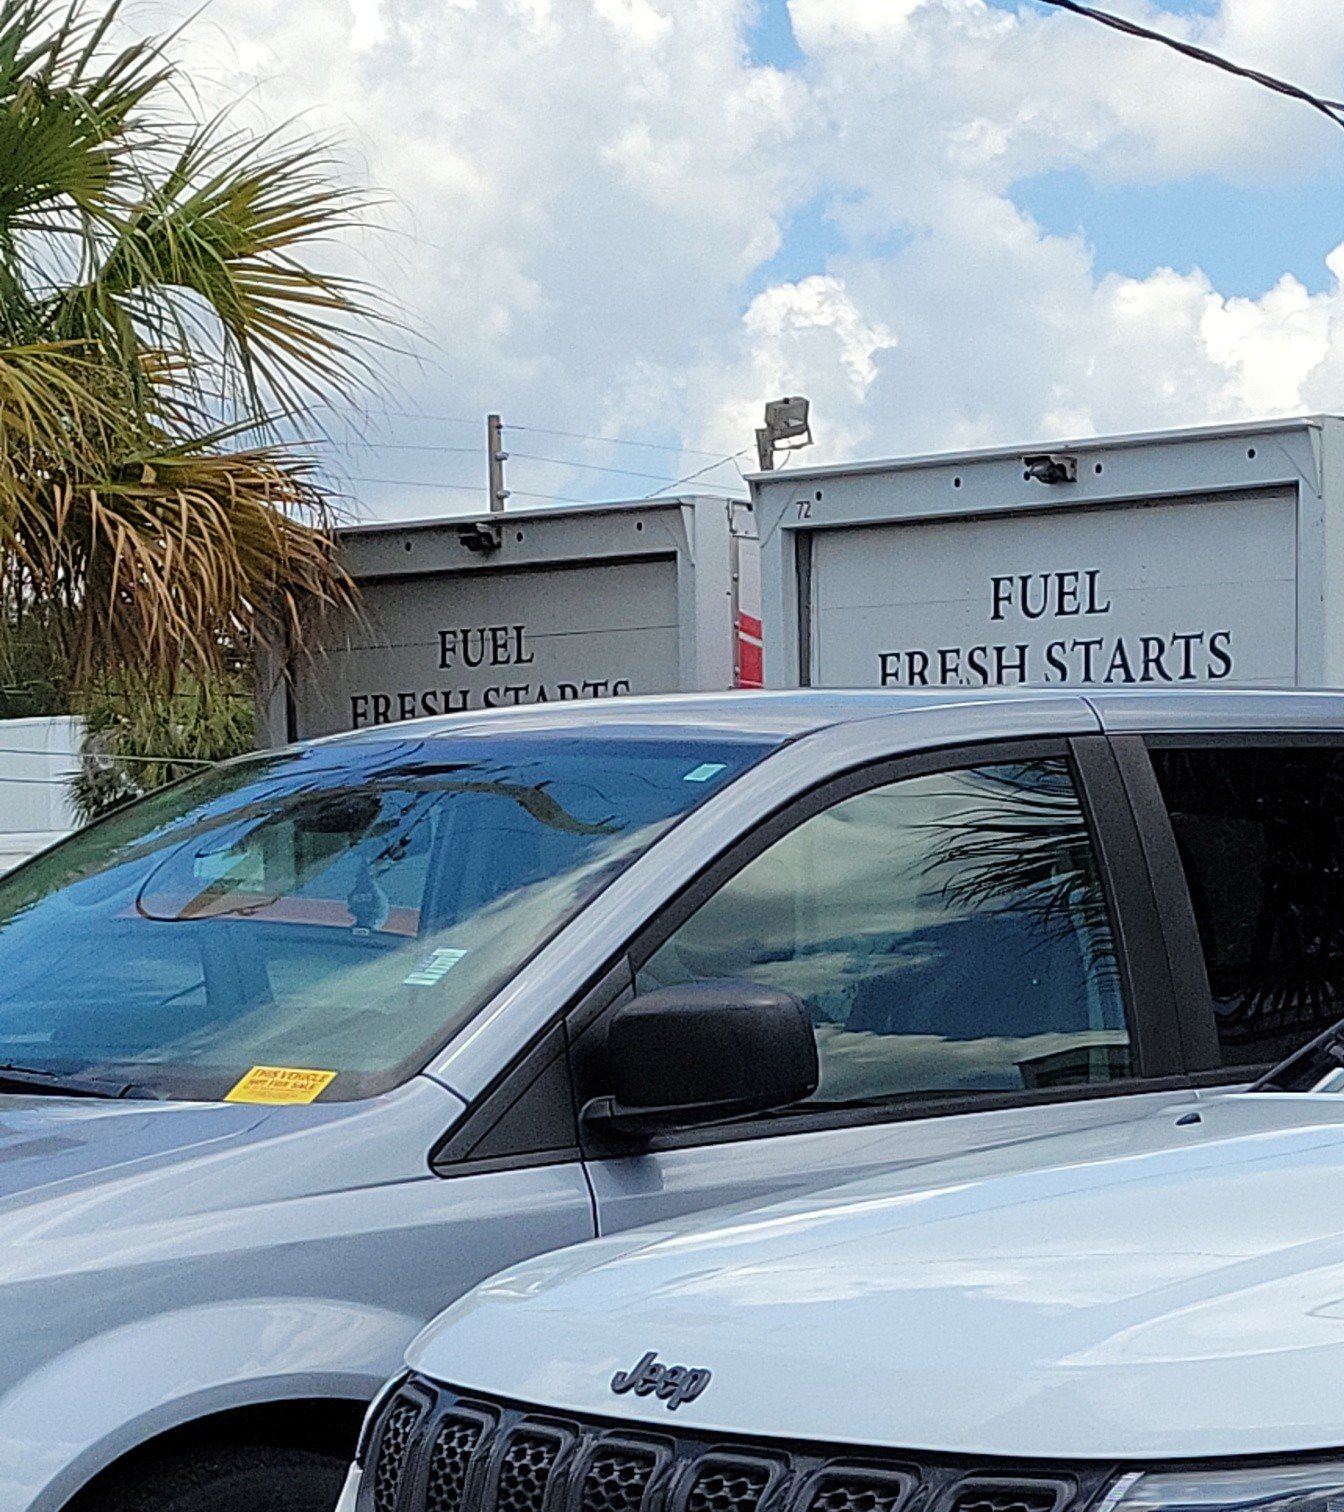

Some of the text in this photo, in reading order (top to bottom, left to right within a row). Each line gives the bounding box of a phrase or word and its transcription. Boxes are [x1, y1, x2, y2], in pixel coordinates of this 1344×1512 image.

[989, 568, 1111, 621] FUEL
[437, 624, 535, 669] FUEL
[879, 629, 1233, 686] FRESH STARTS
[350, 688, 470, 730] FRESH
[610, 1351, 712, 1411] Jeep
